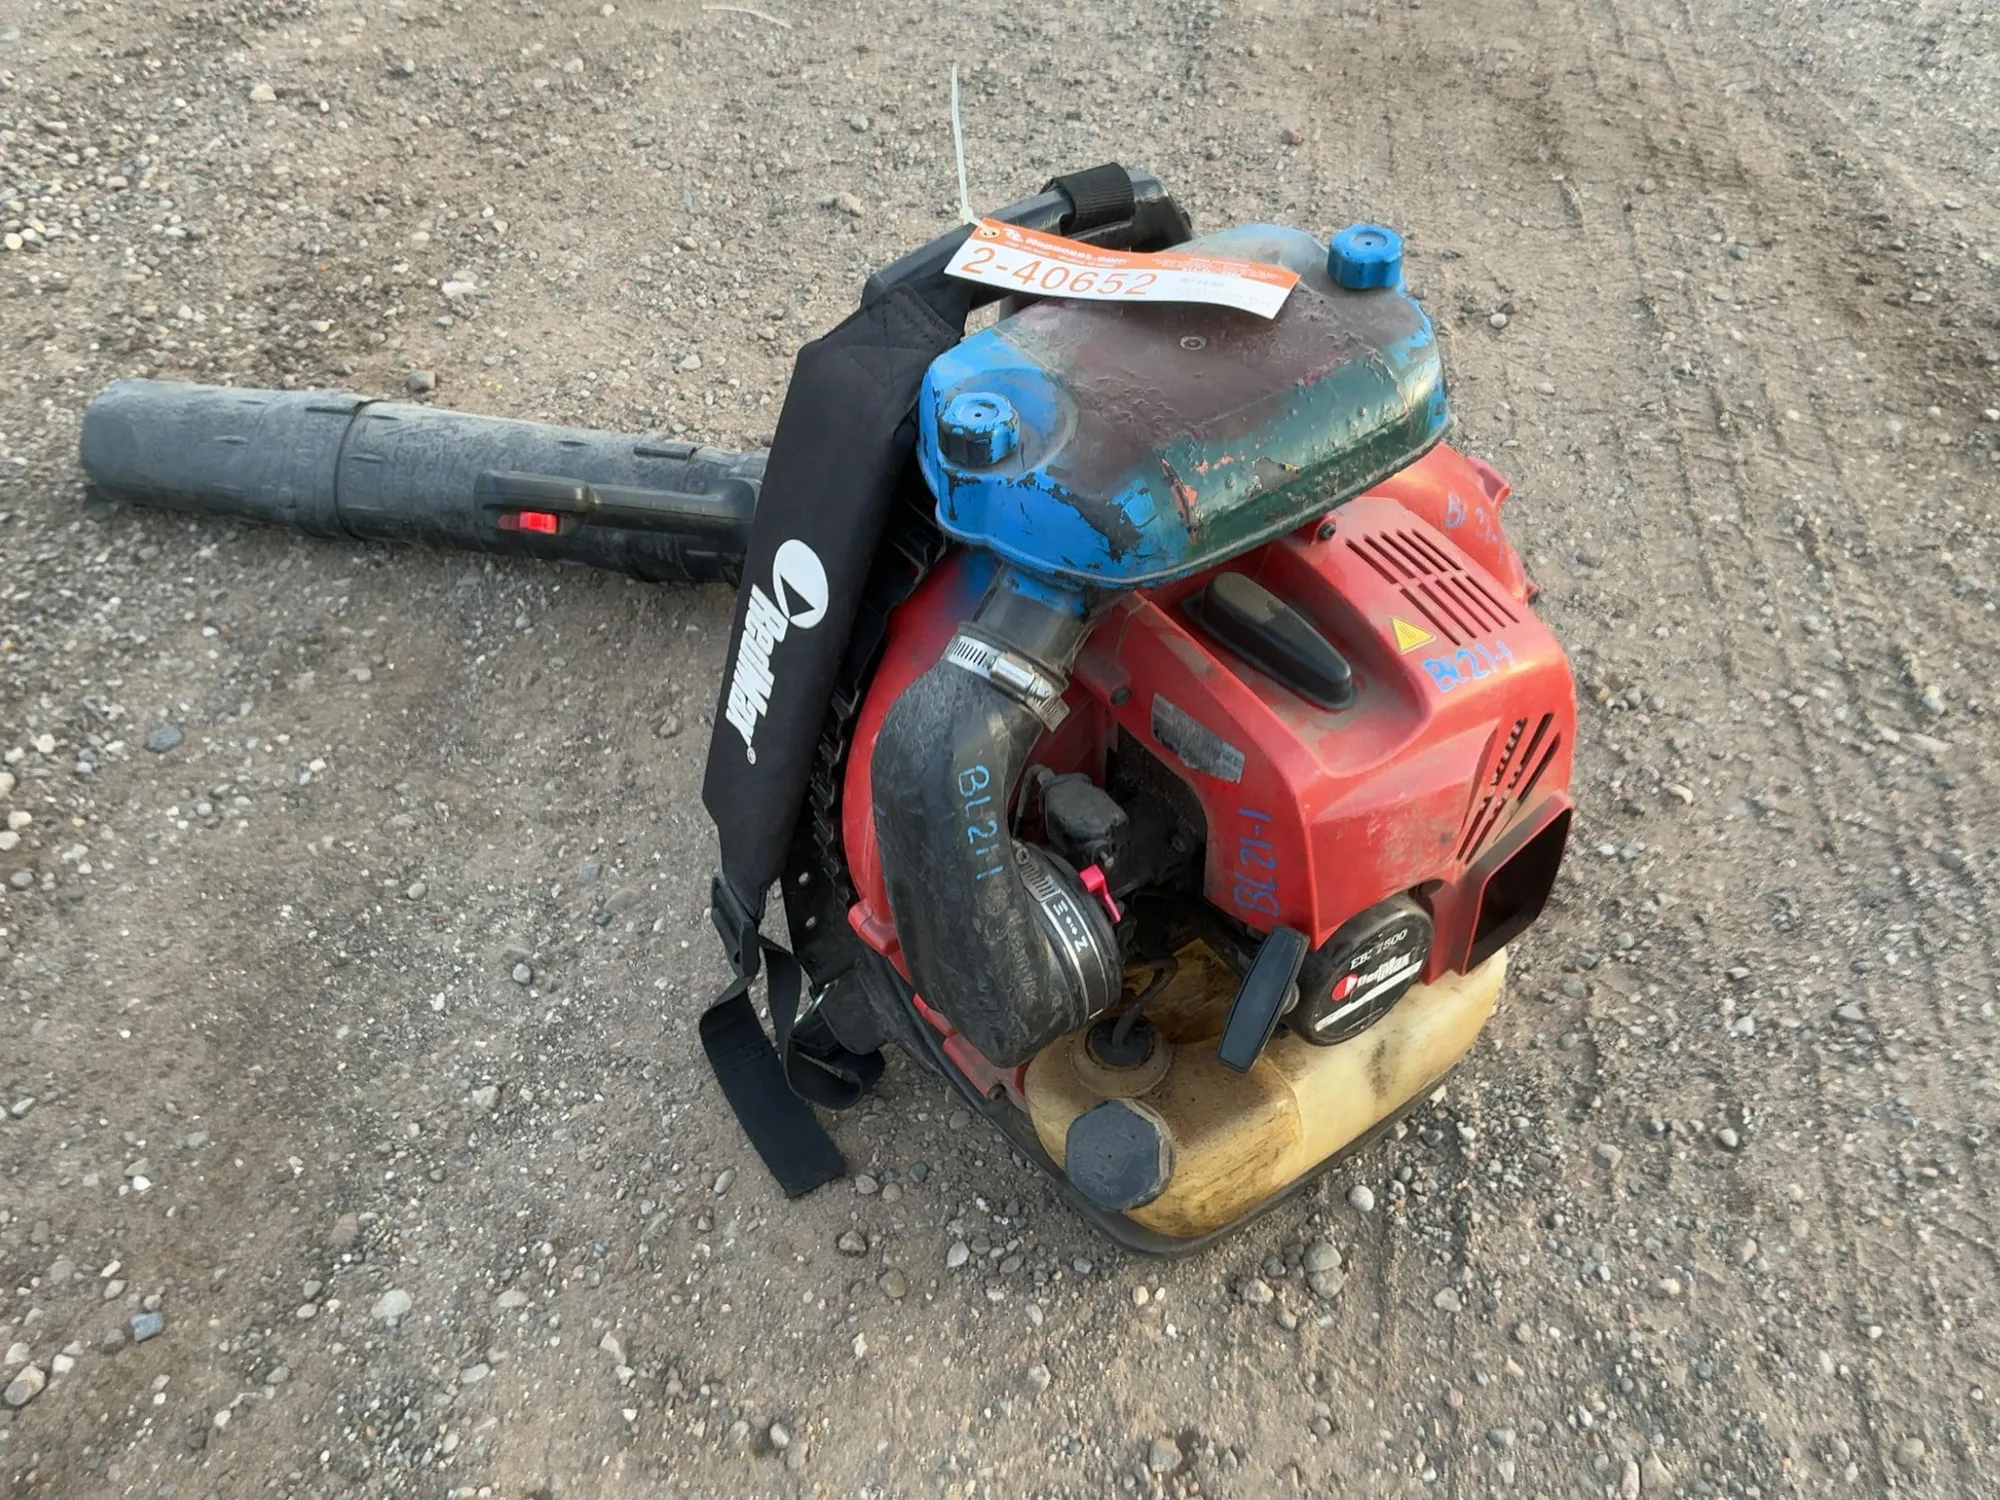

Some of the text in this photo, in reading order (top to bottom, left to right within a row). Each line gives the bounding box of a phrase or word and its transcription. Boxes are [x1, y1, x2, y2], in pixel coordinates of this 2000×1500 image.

[961, 247, 1158, 296] 2-40652
[726, 583, 789, 748] RedMax
[1233, 807, 1281, 917] BL21-1
